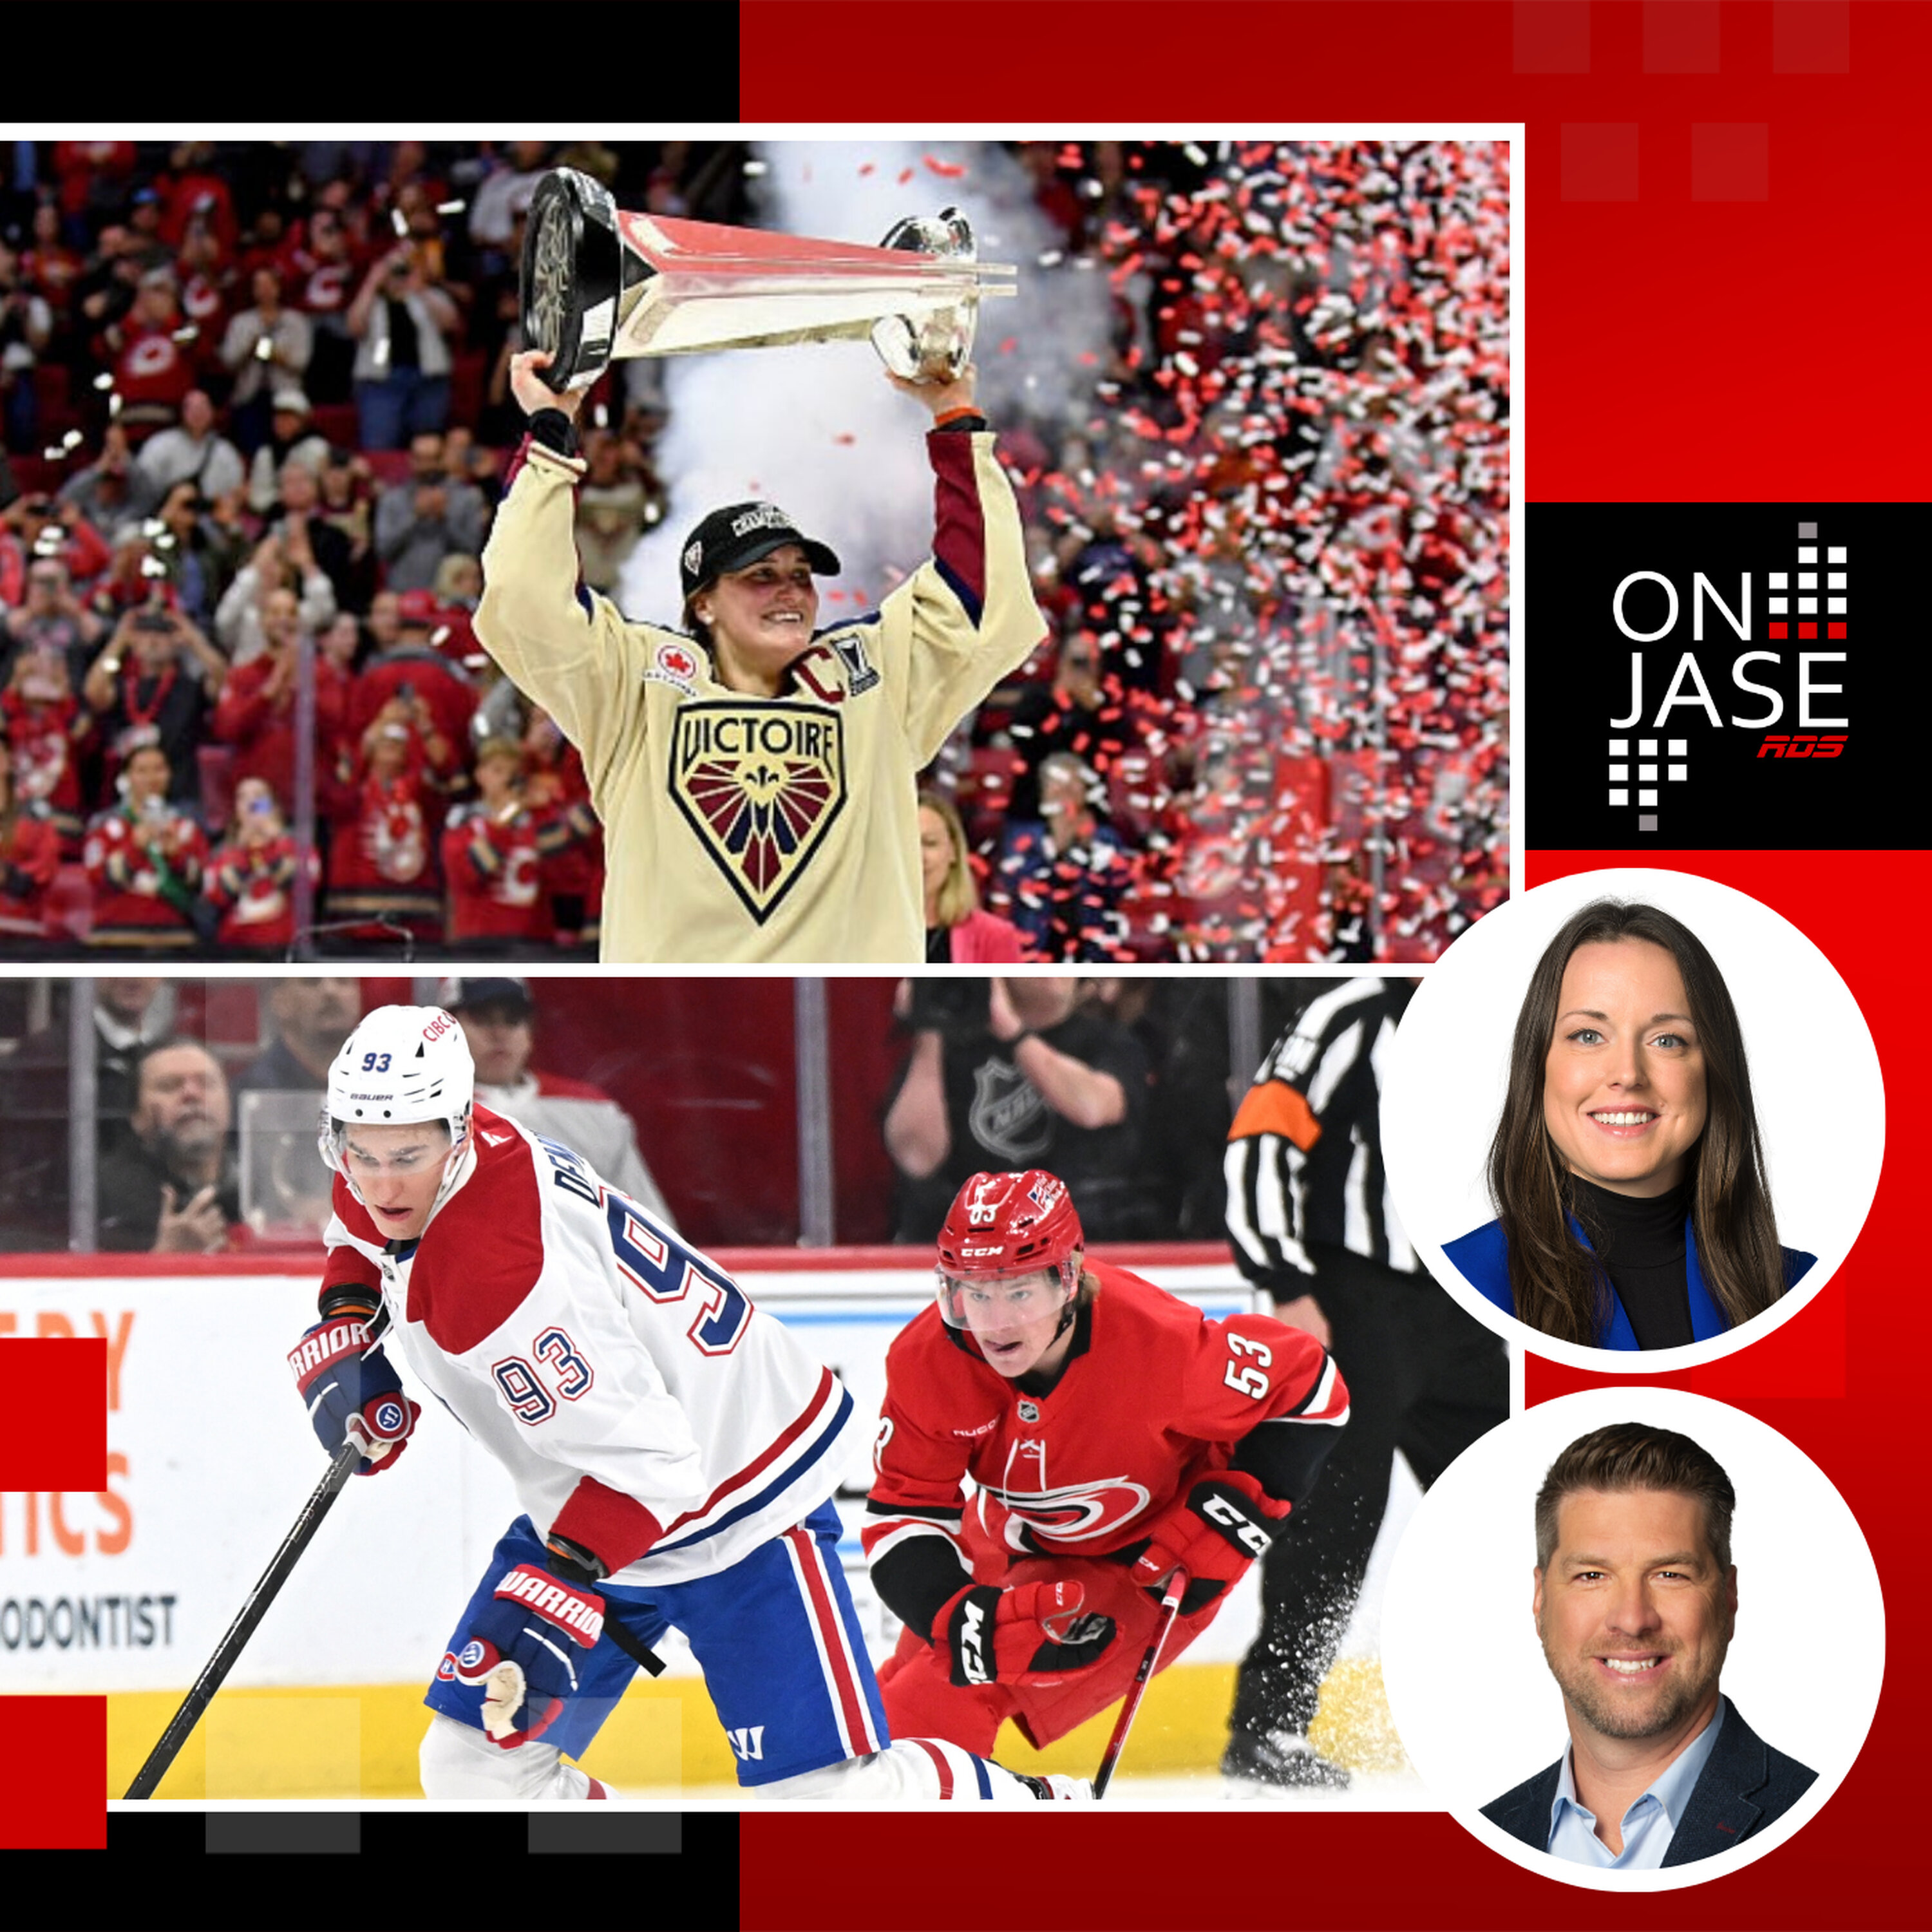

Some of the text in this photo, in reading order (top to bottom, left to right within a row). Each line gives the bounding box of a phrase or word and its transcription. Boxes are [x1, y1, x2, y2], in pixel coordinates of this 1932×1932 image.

[682, 717, 835, 779] VICTOIRE
[361, 1052, 392, 1073] 93
[961, 1246, 1003, 1256] CCM
[491, 1326, 594, 1426] 93
[1224, 1332, 1272, 1400] 53
[0, 1451, 133, 1557] ICS
[1, 1594, 177, 1651] ODONTIST
[961, 1600, 994, 1685] CM
